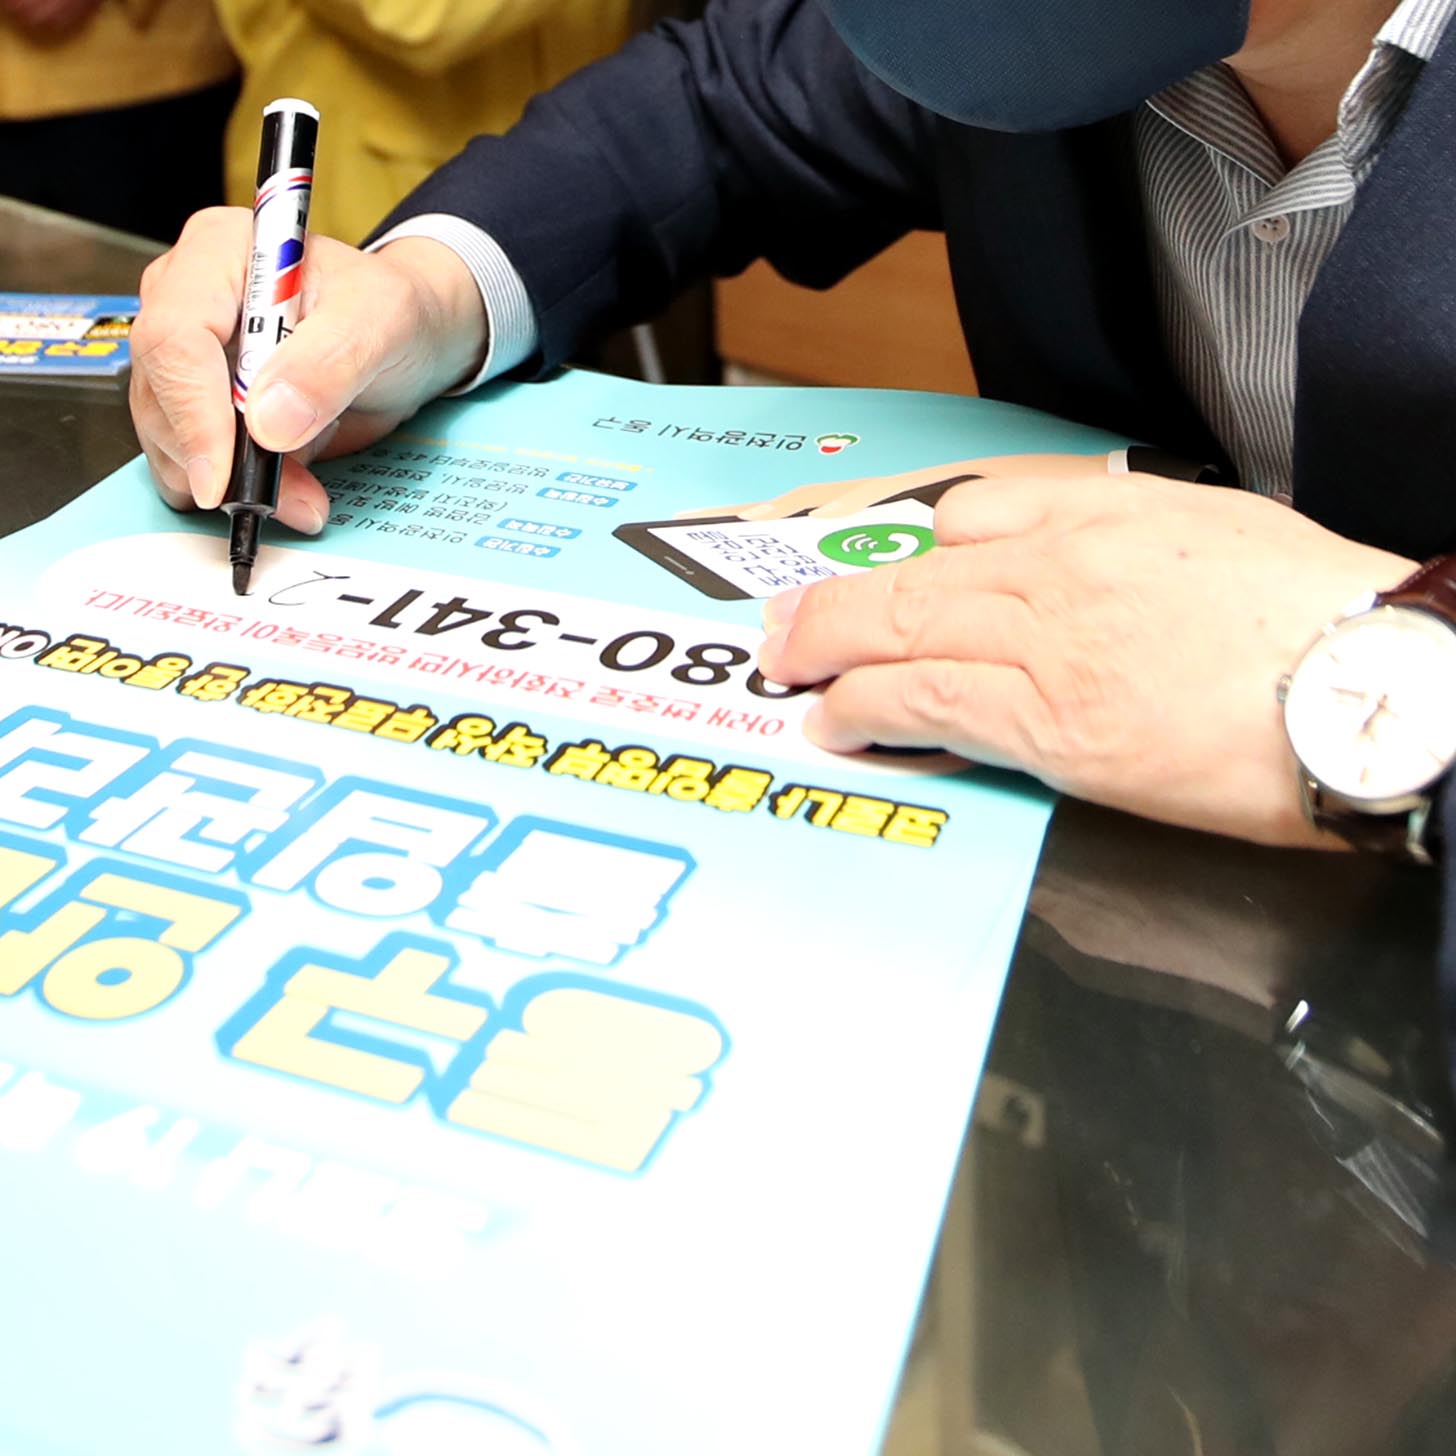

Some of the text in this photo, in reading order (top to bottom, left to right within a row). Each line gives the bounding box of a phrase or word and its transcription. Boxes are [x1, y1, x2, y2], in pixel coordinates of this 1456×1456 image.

[592, 416, 807, 452] 인천광역시 동구
[354, 519, 469, 545] 인천광역시
[373, 500, 419, 516] 예방
[33, 635, 193, 691] 통이면
[84, 588, 784, 737] 아래 번호로 전화하시면 방문등록이 완료됩니다.
[176, 662, 252, 703] 한
[235, 679, 438, 745] 무료전화
[427, 713, 548, 769] 작성
[543, 739, 772, 813] 출입명부
[769, 784, 948, 848] 코로나
[217, 936, 730, 1179] 동구
